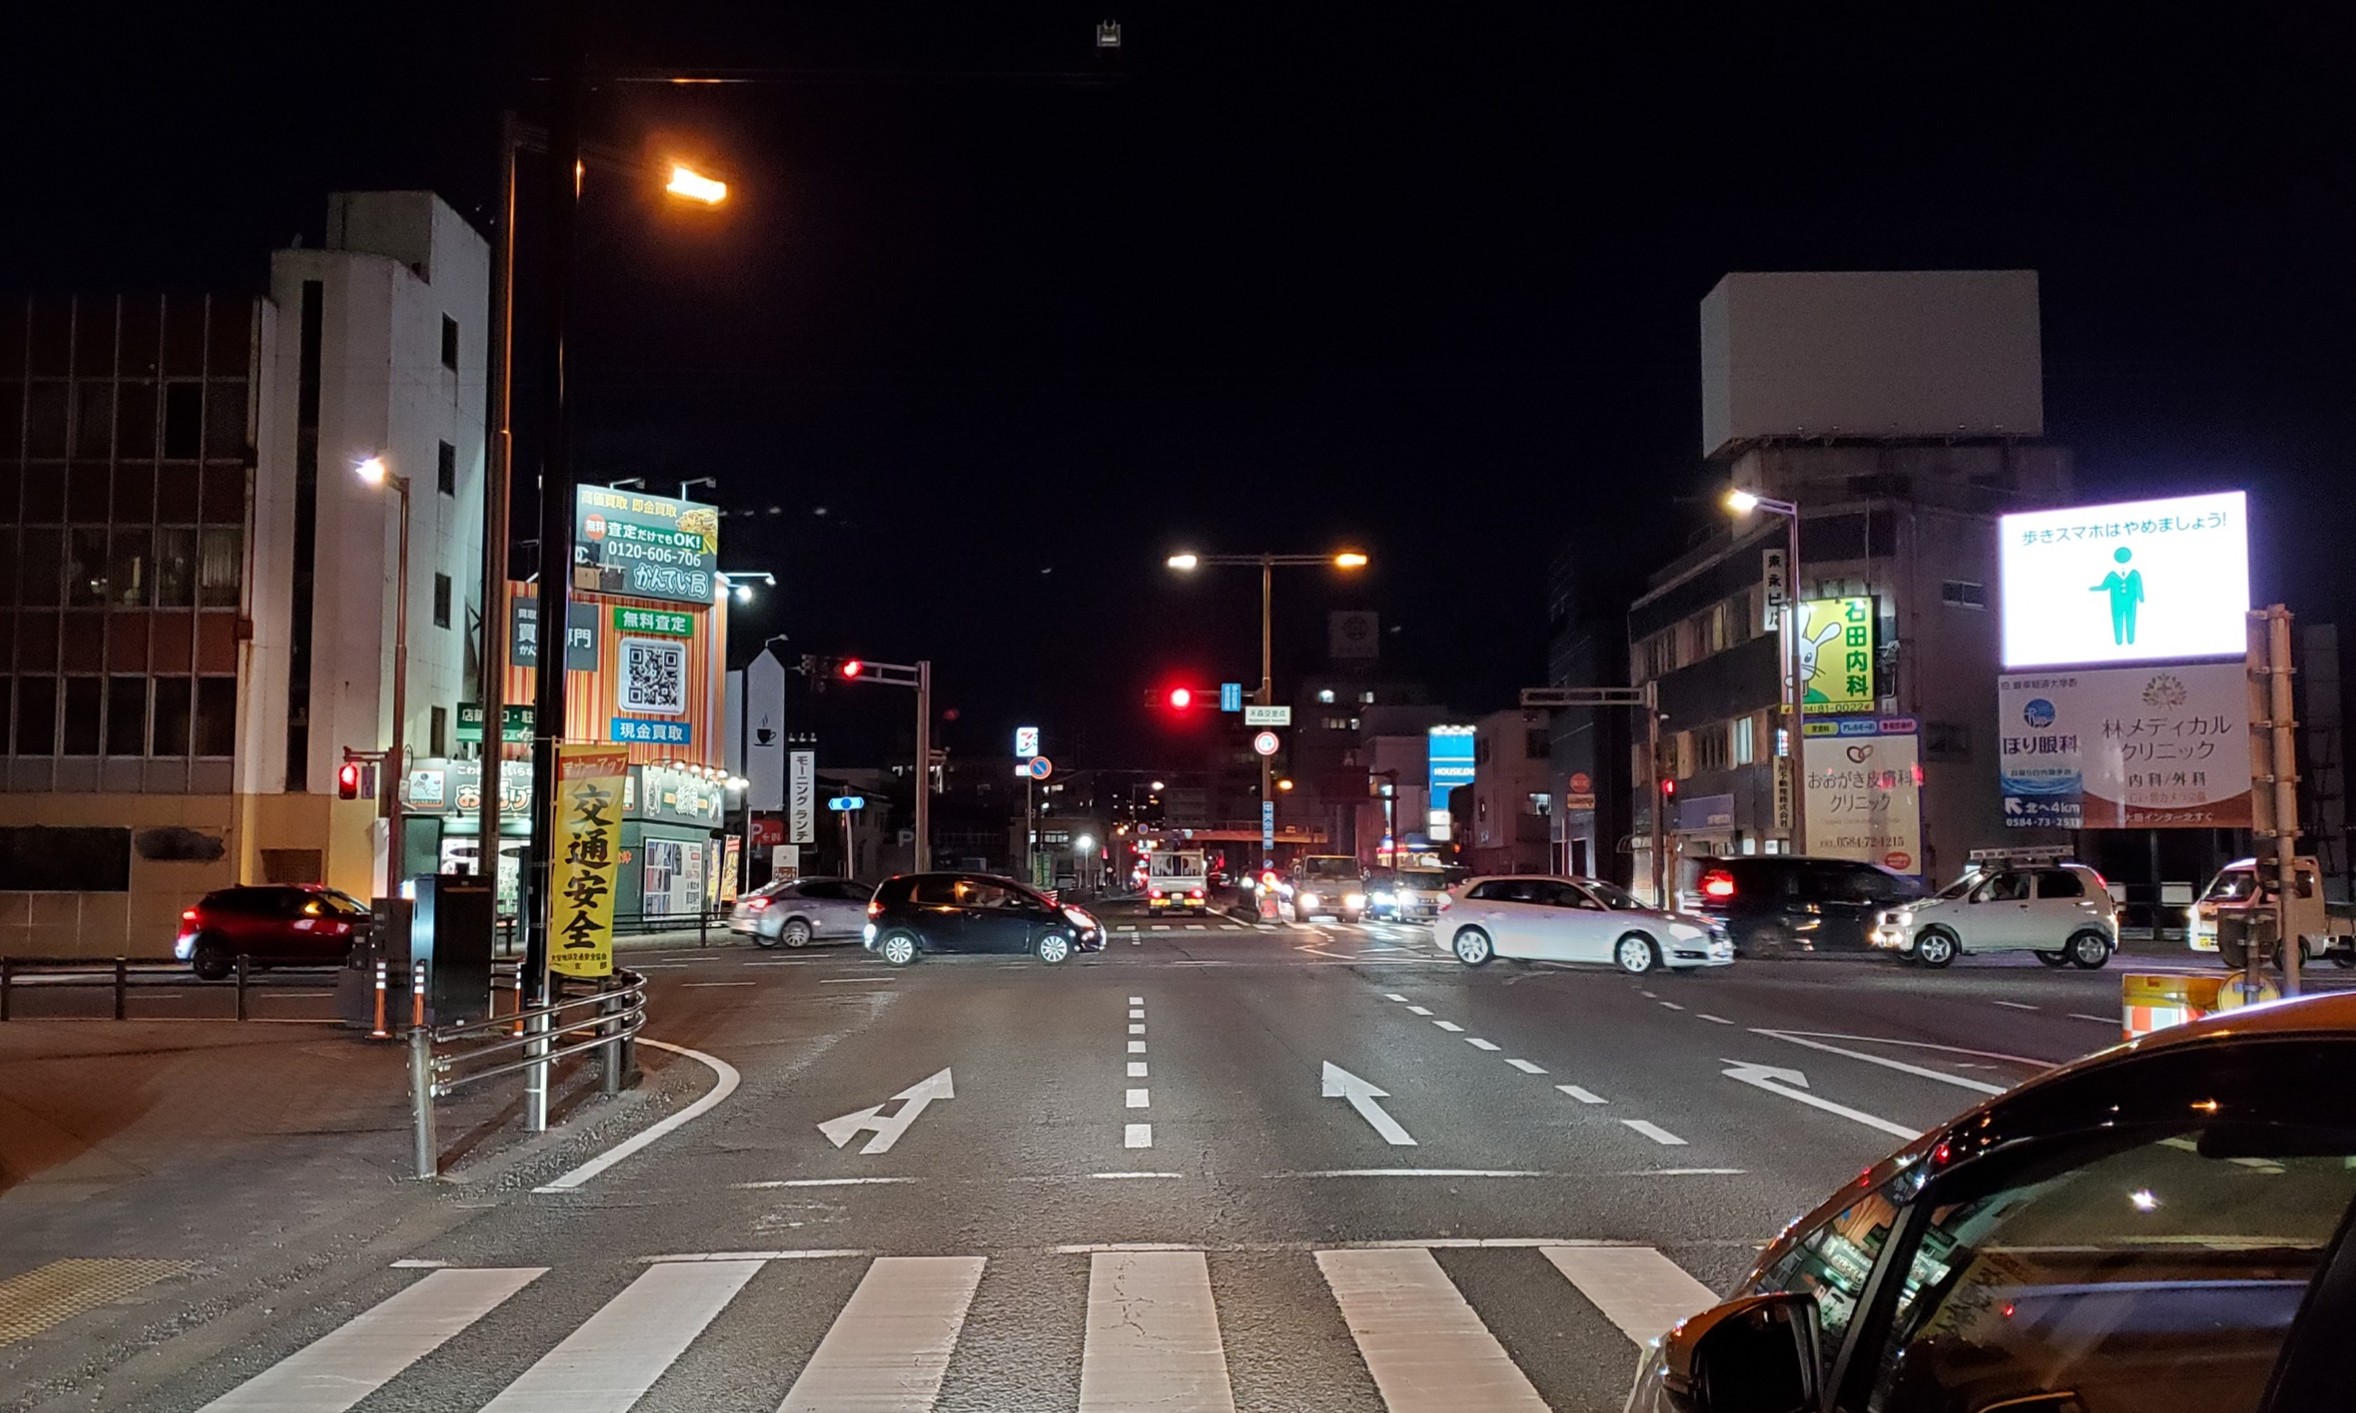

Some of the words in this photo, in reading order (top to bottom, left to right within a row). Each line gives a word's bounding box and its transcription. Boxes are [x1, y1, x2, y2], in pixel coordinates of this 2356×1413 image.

[607, 521, 700, 549] 査定だけでもOK!
[2022, 511, 2227, 547] 歩きスマホはやめましょう!
[607, 540, 701, 568] 0120-606-706
[633, 561, 709, 599] かんてい局
[623, 610, 686, 632] 無料査定
[1845, 600, 1869, 697] 石田内科
[620, 722, 682, 741] 現金買取
[2102, 716, 2232, 739] 林メディカル
[2003, 735, 2077, 755] ほり眼科
[2121, 740, 2215, 761] クリニック
[796, 755, 808, 806] モーニング
[1808, 768, 1912, 789] おおがき皮膚科
[1831, 793, 1891, 813] クリニック
[796, 809, 808, 842] ランチ
[561, 784, 614, 950] 交通安全
